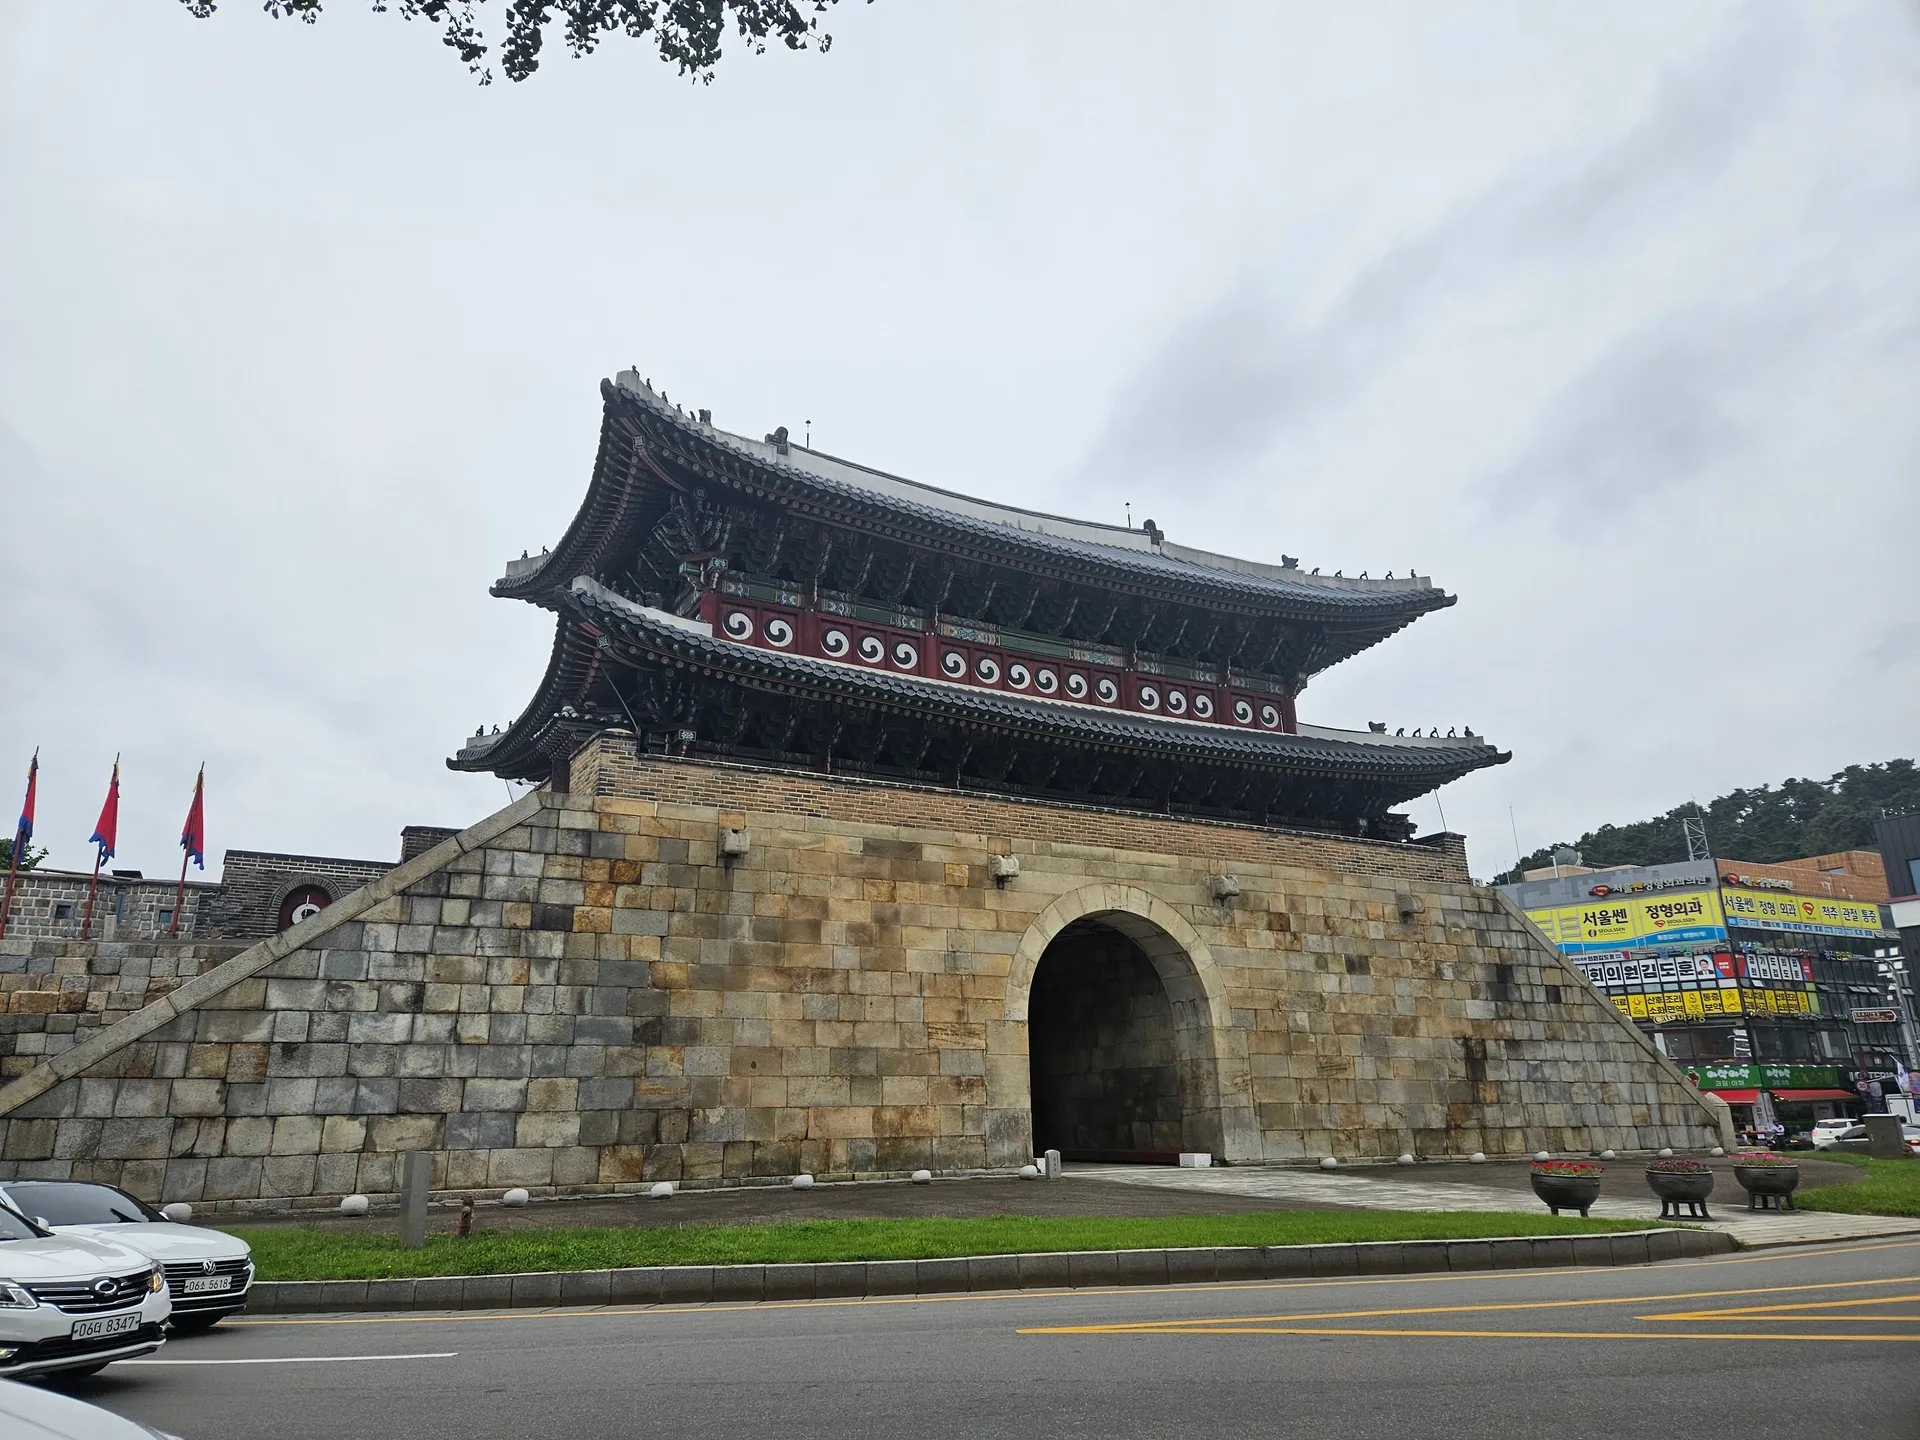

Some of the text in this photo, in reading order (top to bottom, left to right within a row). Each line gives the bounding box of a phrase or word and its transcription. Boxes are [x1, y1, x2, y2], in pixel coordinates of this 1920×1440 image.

[1583, 901, 1703, 926] 서울쎈 정형외과
[1725, 896, 1755, 912] 서울쎈
[1822, 905, 1839, 919] 척추
[1842, 907, 1859, 921] 관절
[1862, 909, 1877, 924] 통증
[189, 1279, 227, 1290] 06소 5618
[106, 1316, 135, 1332] 8347
